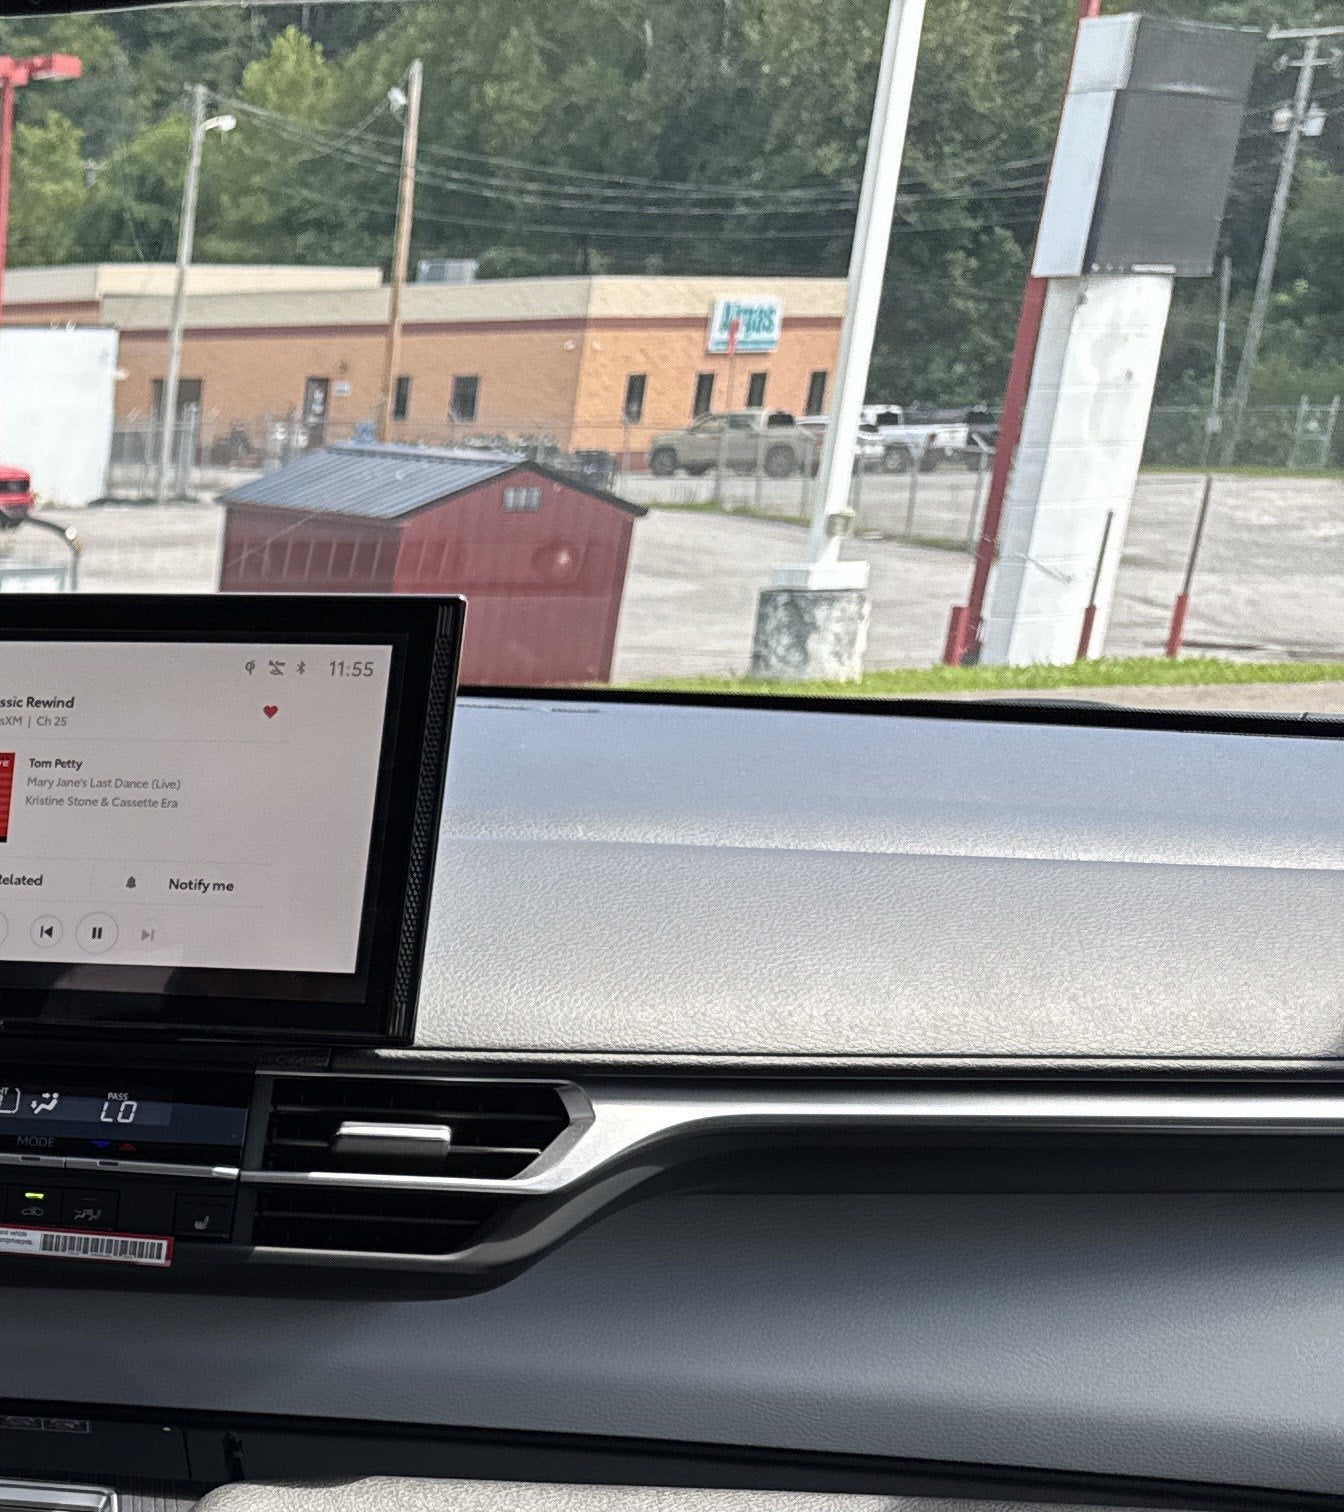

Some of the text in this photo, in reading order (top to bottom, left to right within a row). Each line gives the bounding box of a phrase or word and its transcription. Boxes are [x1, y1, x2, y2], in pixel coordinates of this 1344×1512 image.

[328, 660, 374, 678] 11:55
[26, 696, 74, 709] Rewind
[36, 716, 51, 727] Ch
[54, 716, 67, 727] 25
[29, 758, 82, 771] Tom Petty
[26, 776, 181, 791] Mary Jane's Last Dance (Live)
[25, 795, 178, 809] Kristine Stone & Cassette Era
[168, 879, 234, 894] Notify me
[100, 1101, 138, 1123] LO
[17, 1136, 55, 1147] MODE
